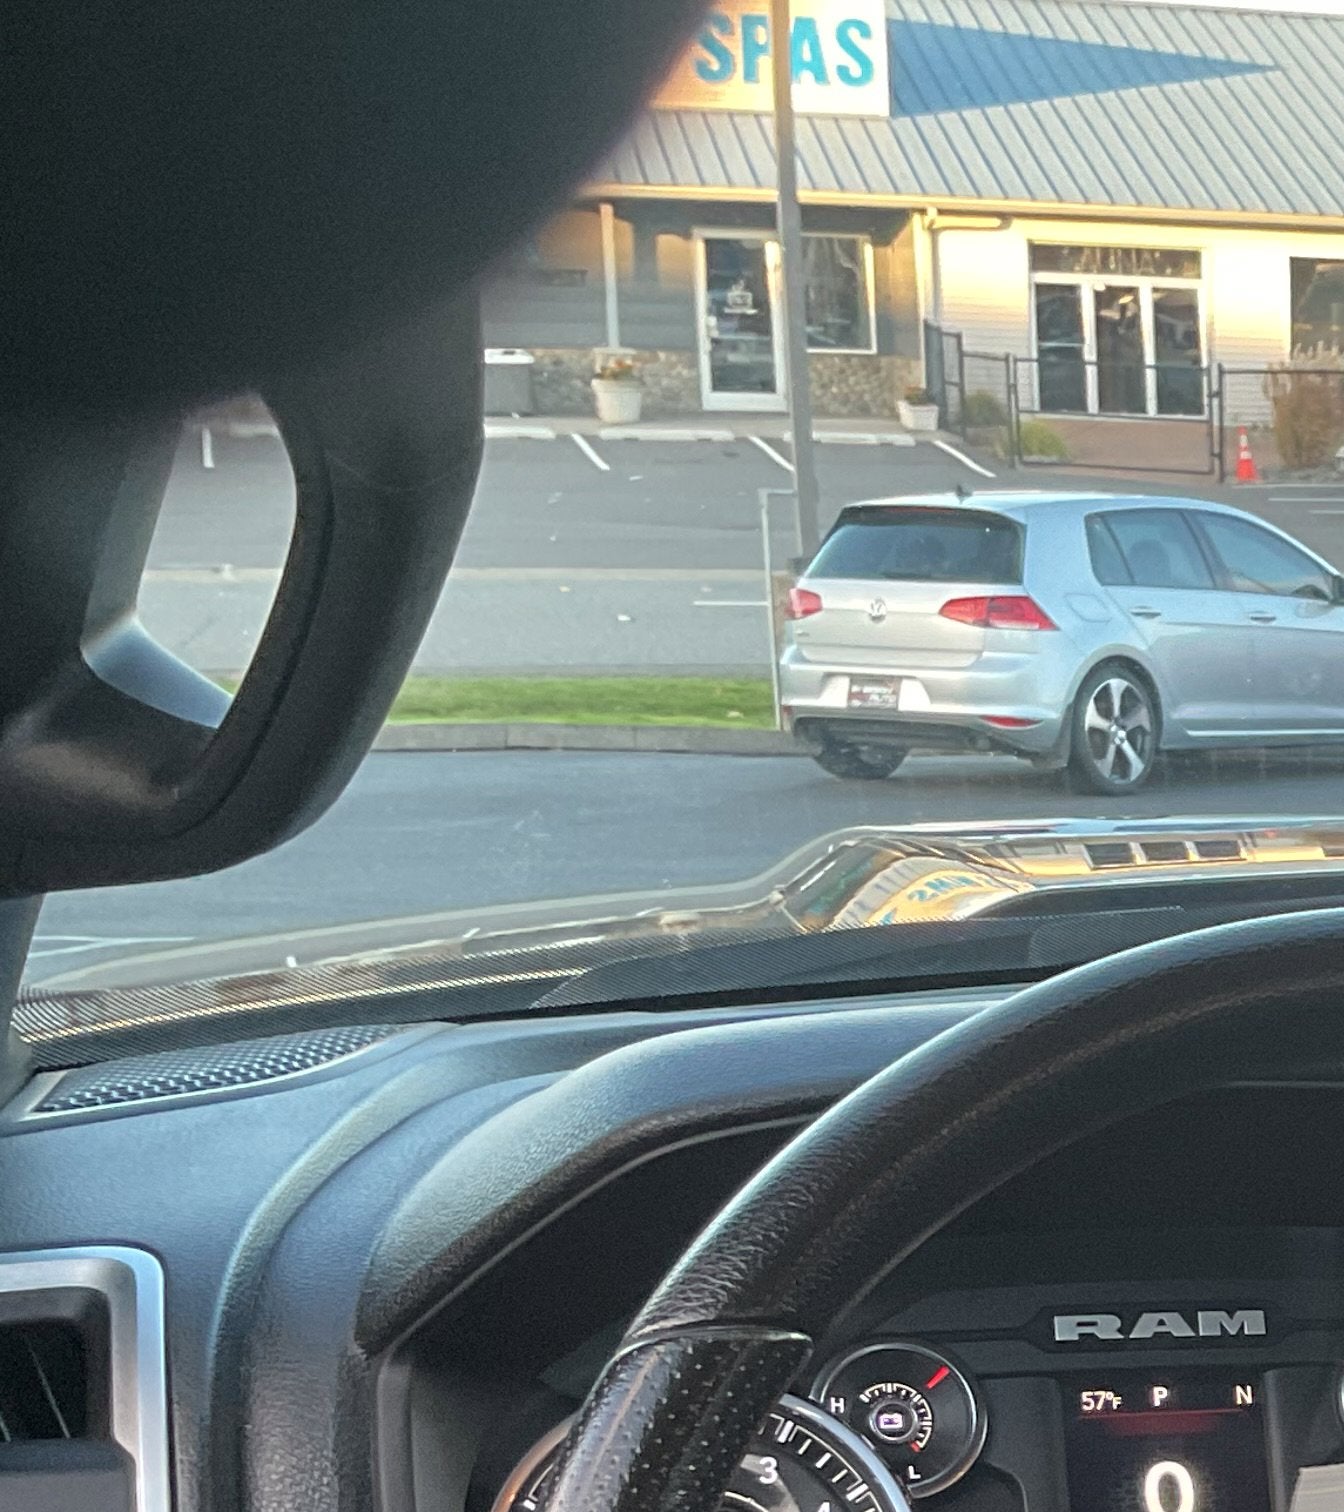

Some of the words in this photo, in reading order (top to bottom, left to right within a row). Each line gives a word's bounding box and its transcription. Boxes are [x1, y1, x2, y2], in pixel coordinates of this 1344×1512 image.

[694, 12, 875, 87] SPAS
[1053, 1309, 1267, 1341] RAM
[1080, 1390, 1122, 1411] 57°F
[1152, 1386, 1168, 1406] P
[1235, 1385, 1253, 1405] N
[830, 1397, 845, 1414] H
[758, 1456, 779, 1485] 3
[908, 1465, 921, 1480] L
